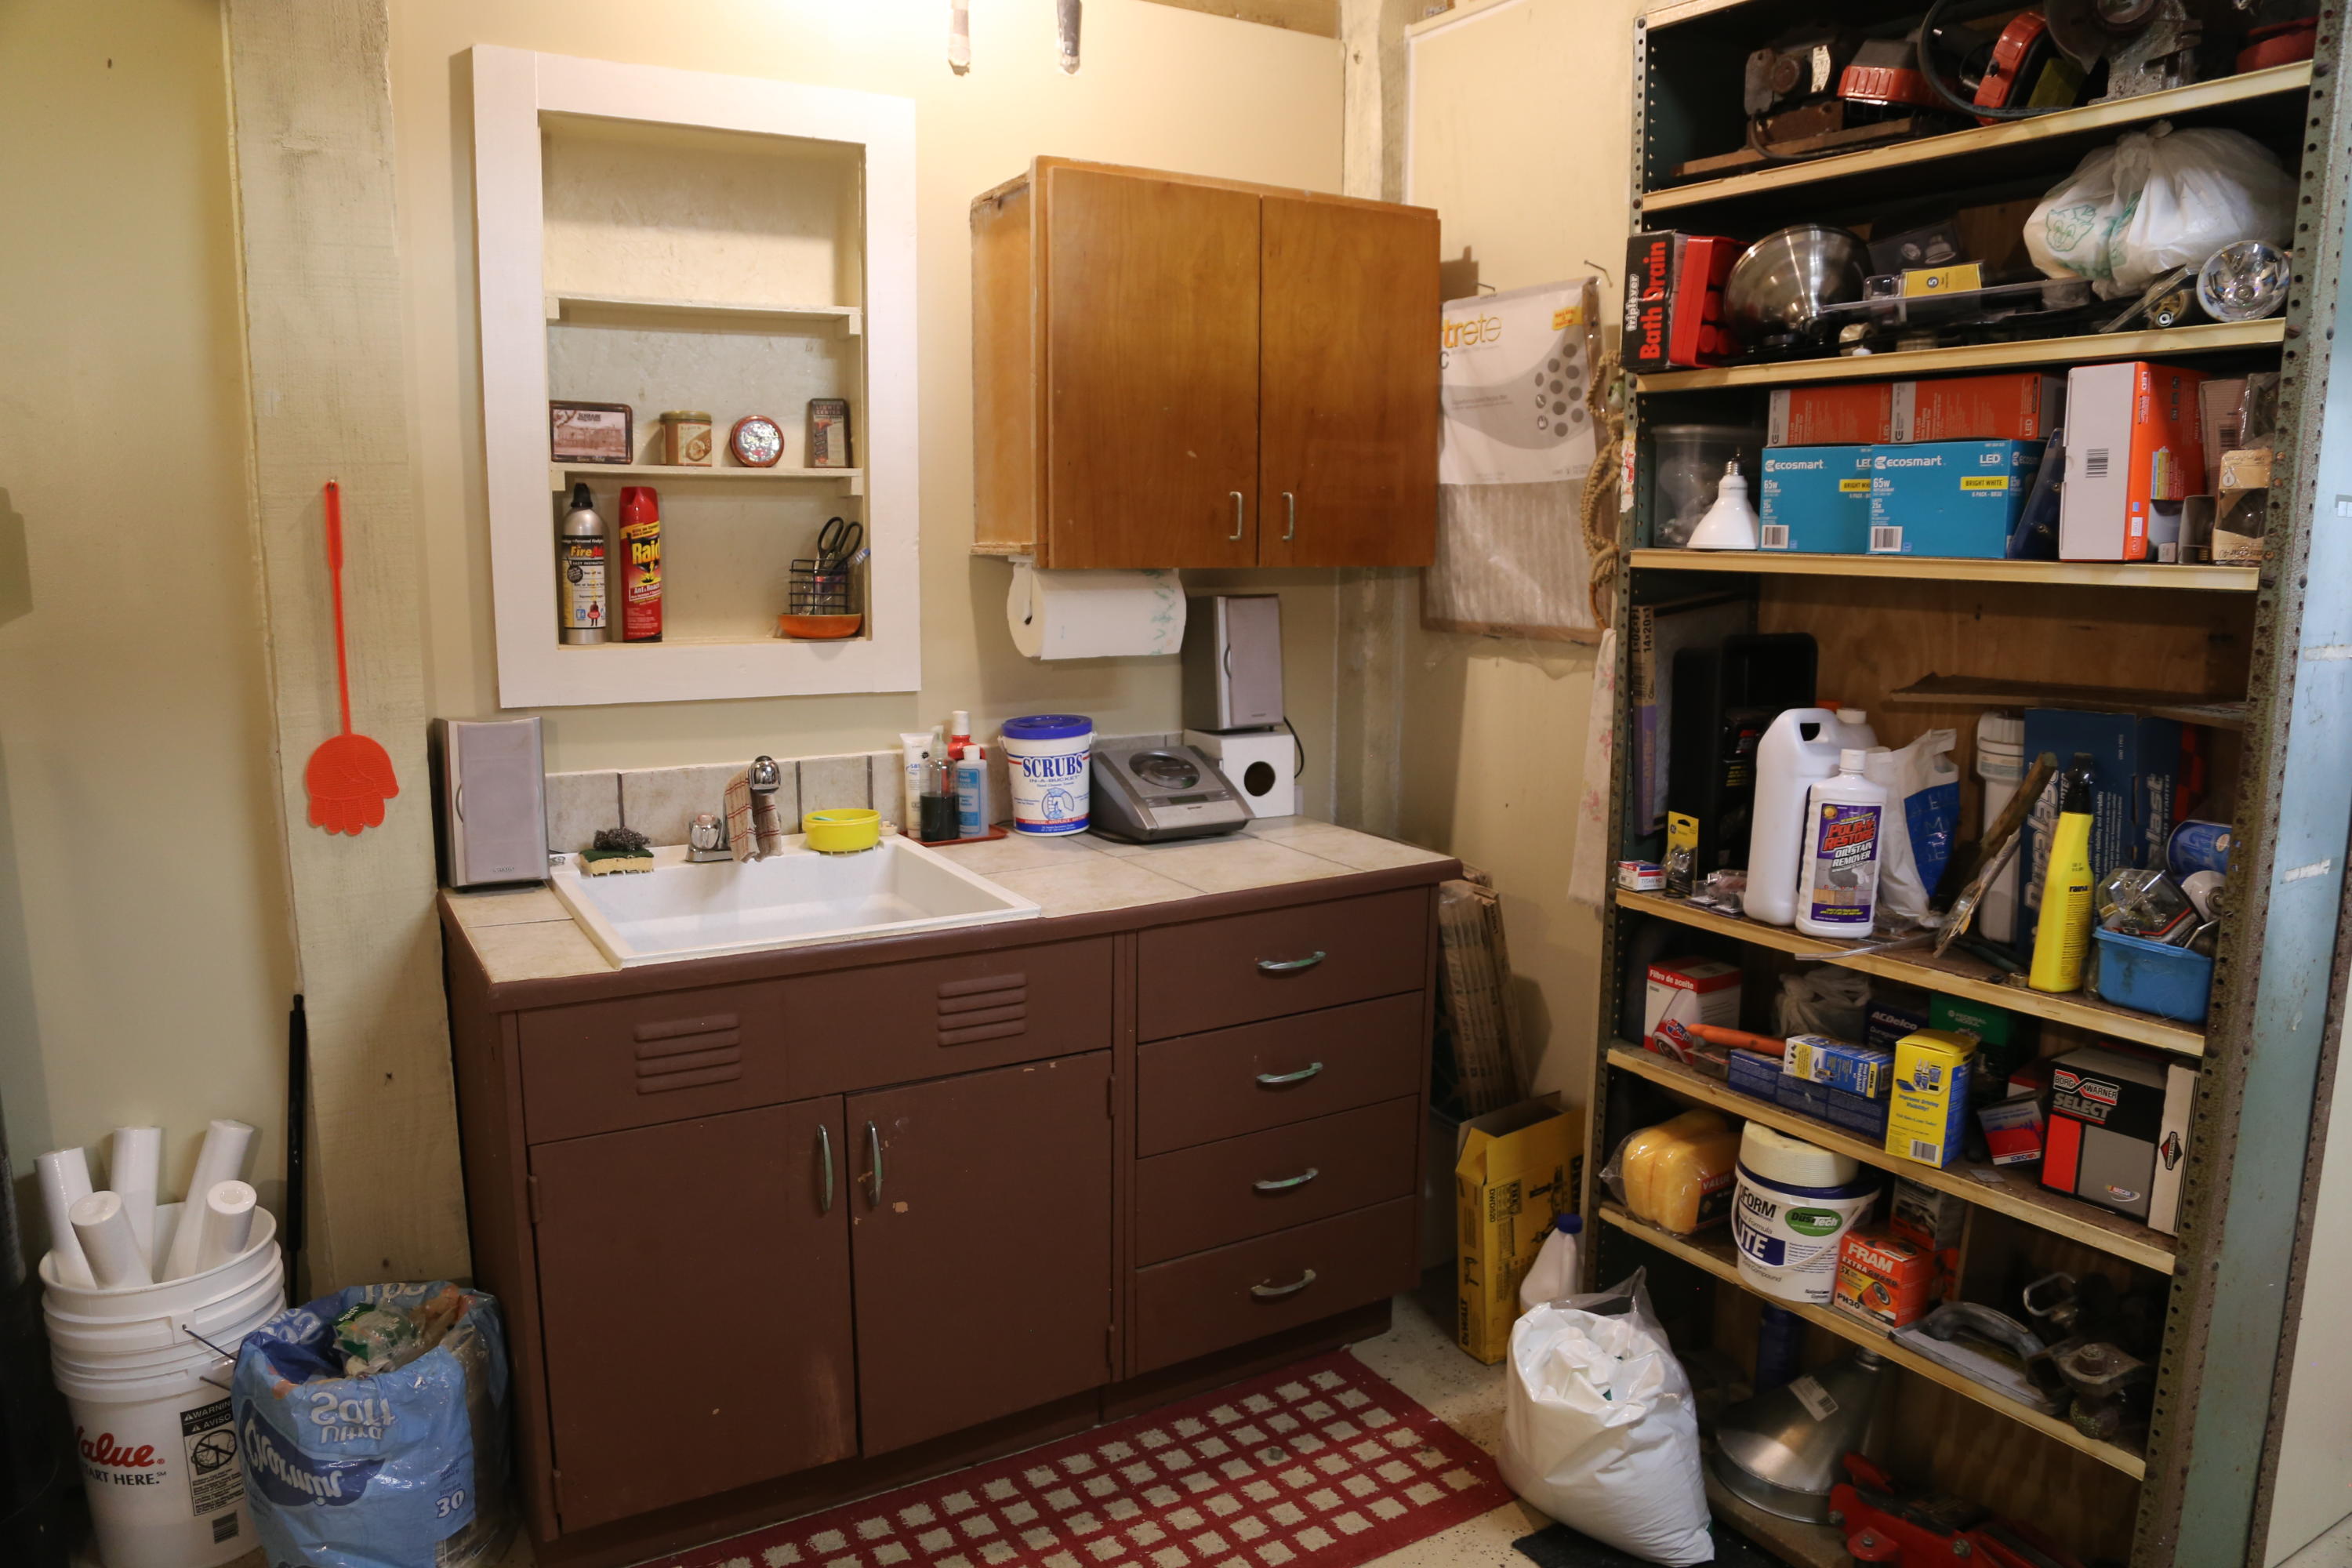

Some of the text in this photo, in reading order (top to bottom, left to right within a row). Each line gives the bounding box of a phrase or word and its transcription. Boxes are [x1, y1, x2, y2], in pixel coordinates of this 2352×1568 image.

[1625, 274, 1640, 332] triplever
[1639, 241, 1667, 359] Bath Drain
[1442, 314, 1501, 348] trete
[2024, 419, 2033, 437] LED
[1775, 459, 1824, 470] ecosmart
[1886, 456, 1943, 466] ecosmart
[1980, 454, 2001, 464] LED
[632, 537, 660, 565] Raid
[1022, 754, 1083, 778] SCRUBS
[1832, 850, 1871, 867] REMOVER
[1835, 841, 1873, 858] OIL STAIN
[1650, 969, 1694, 990] Filtro de aceite
[1871, 1011, 1918, 1031] ACDelco
[2055, 1076, 2075, 1087] BORG
[2085, 1084, 2117, 1098] WARNER
[2053, 1093, 2112, 1119] SELECT
[1748, 1218, 1773, 1235] Formula
[1737, 1221, 1768, 1258] ITE
[1848, 1242, 1895, 1273] FRAM
[1837, 1293, 1860, 1309] PH30
[192, 1399, 232, 1419] WARNIN
[203, 1412, 232, 1429] AVISO
[76, 1425, 155, 1468] alue
[113, 1472, 160, 1486] HERE.
